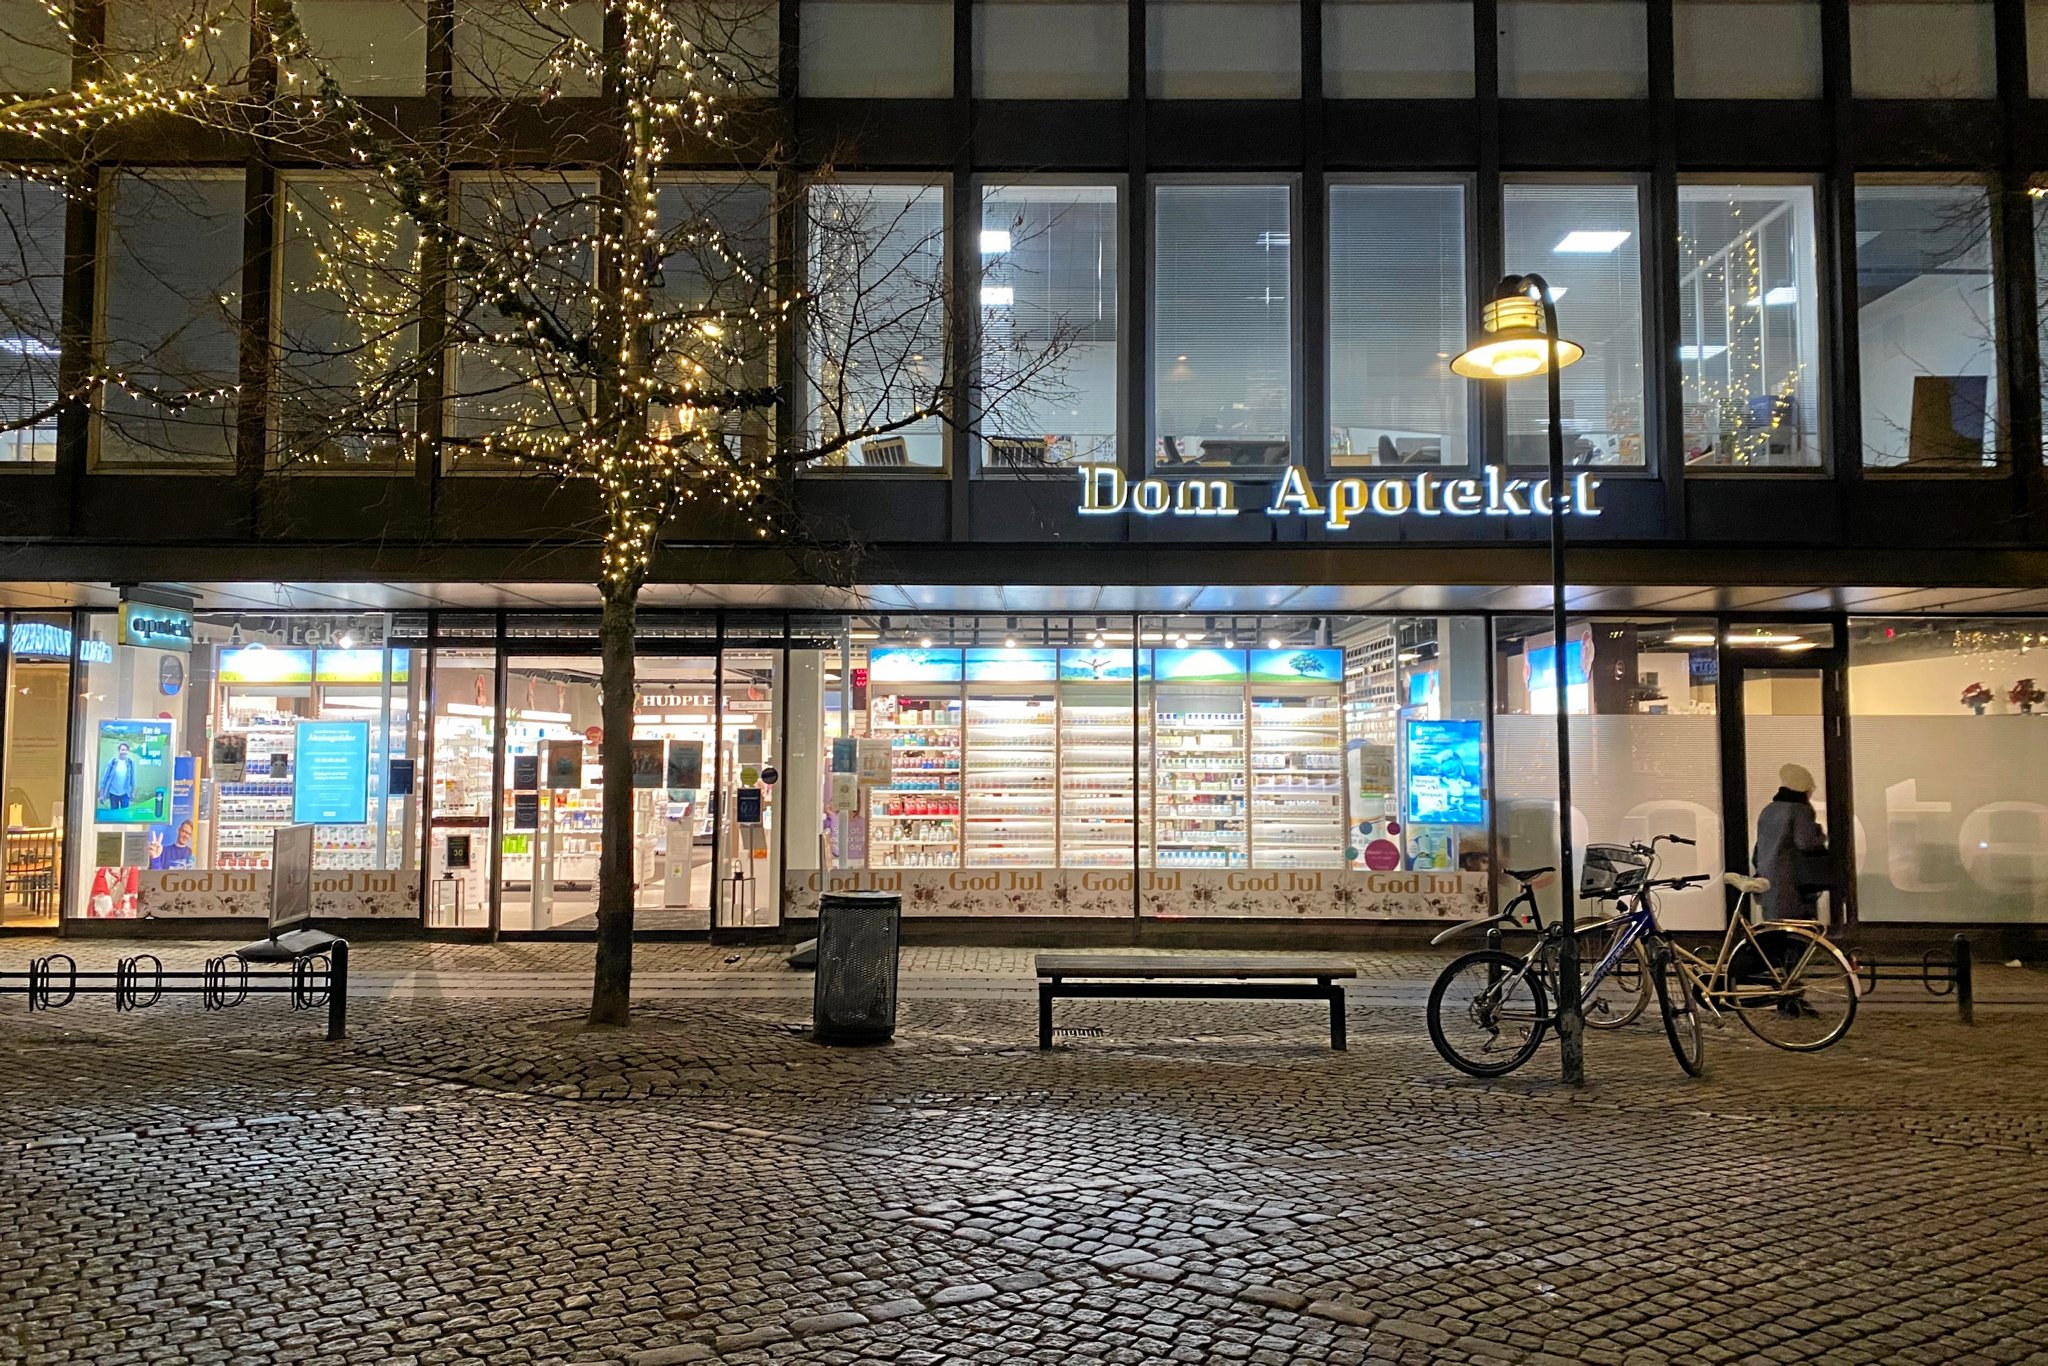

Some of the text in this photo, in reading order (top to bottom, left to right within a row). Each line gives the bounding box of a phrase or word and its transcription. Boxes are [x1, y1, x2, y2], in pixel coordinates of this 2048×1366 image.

[1077, 465, 1603, 529] Dom Apoteket
[642, 695, 731, 707] HUDPLEE
[160, 873, 256, 892] God Jul
[357, 873, 397, 892] Jul
[867, 872, 904, 891] Jul
[949, 872, 1044, 891] God Jul
[1082, 872, 1183, 891] God Jul
[1227, 872, 1323, 891] God Jul
[1367, 874, 1465, 895] God Jul
